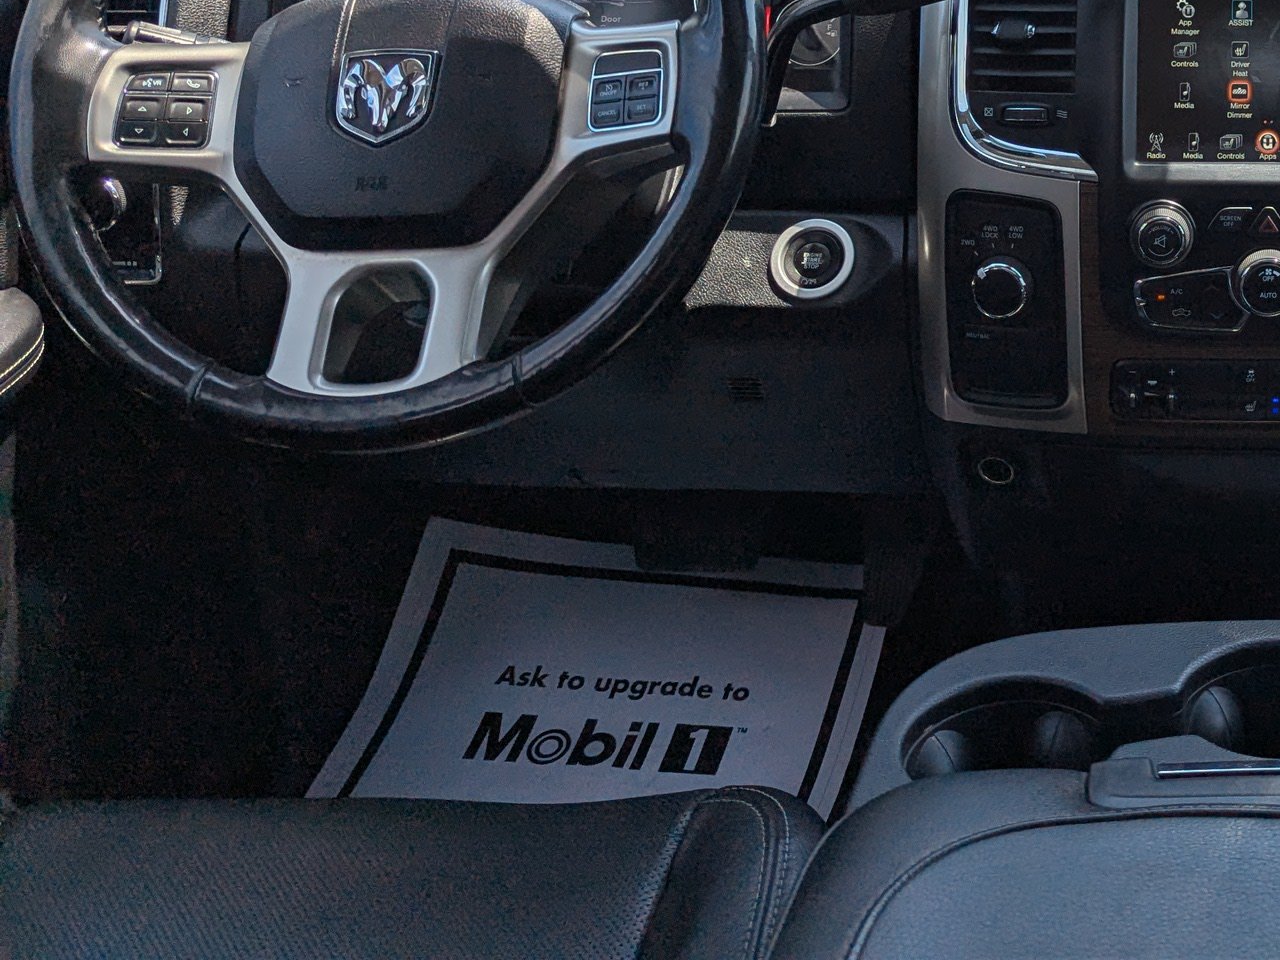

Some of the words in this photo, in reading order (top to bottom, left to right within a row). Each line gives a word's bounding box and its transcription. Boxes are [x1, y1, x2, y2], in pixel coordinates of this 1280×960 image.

[600, 15, 621, 23] Door
[1228, 19, 1254, 27] ASSIST
[1178, 19, 1193, 28] App
[1170, 28, 1200, 37] Manager
[1170, 60, 1199, 68] Controls
[1230, 60, 1251, 68] Driver
[597, 109, 617, 118] CANCEL
[1226, 111, 1253, 119] Dimmer
[1146, 151, 1166, 159] Radio
[1216, 152, 1245, 160] Controls
[1259, 153, 1277, 161] Apps
[494, 665, 550, 689] Ask
[557, 670, 586, 692] to
[594, 675, 714, 702] upgrade
[721, 681, 751, 703] to
[462, 711, 660, 771] Mobil
[667, 726, 723, 773] 1
